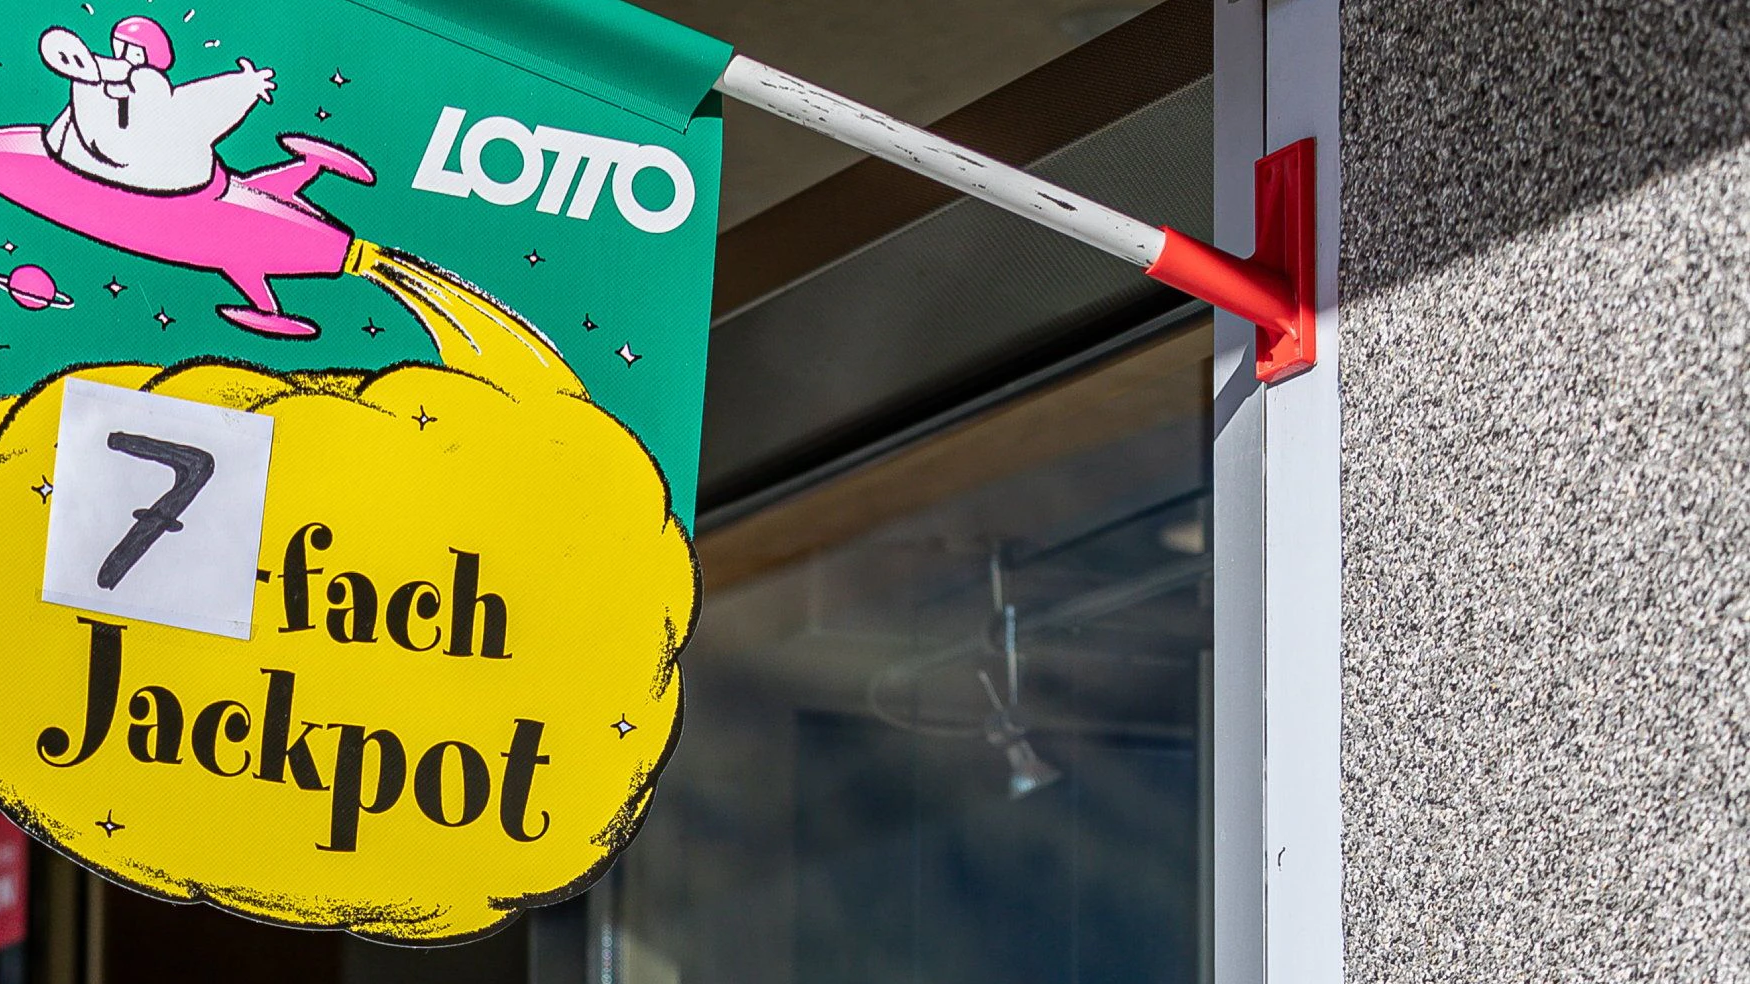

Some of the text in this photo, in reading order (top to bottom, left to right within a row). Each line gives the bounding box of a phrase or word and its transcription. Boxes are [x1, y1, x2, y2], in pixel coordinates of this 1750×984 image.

[411, 105, 696, 233] LOTTO
[96, 431, 215, 591] 7
[36, 616, 551, 853] Jackpot
